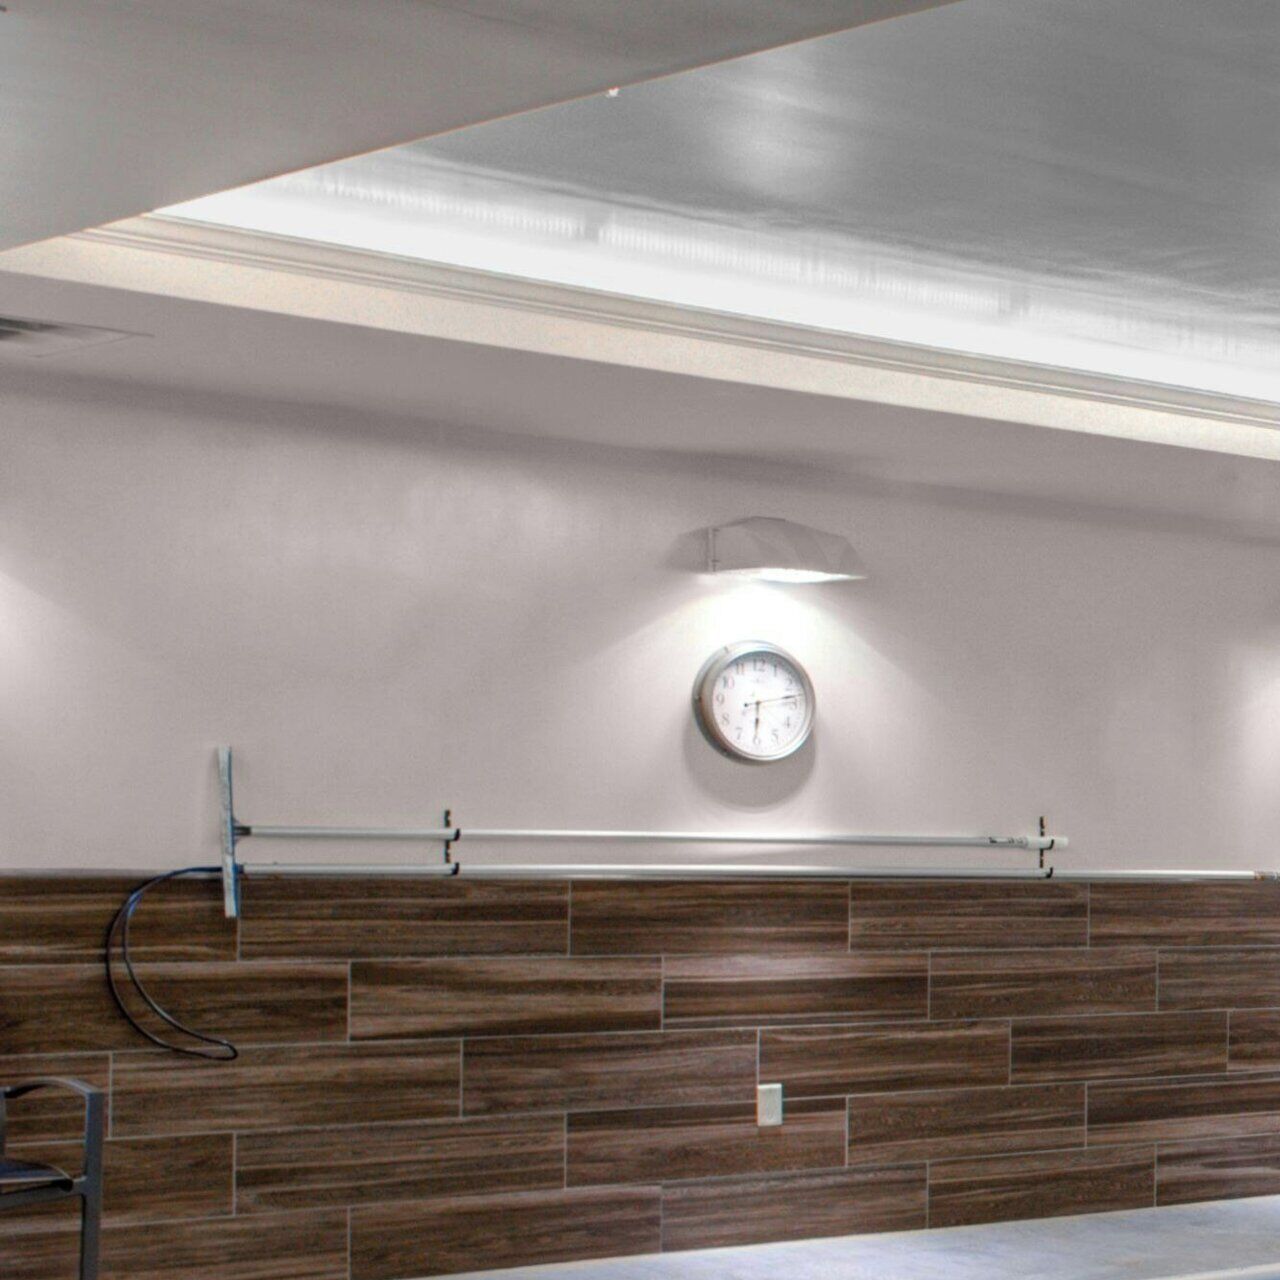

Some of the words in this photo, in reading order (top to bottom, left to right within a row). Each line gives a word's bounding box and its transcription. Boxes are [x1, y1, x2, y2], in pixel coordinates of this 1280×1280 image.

[753, 658, 766, 672] 12
[717, 693, 725, 704] 9
[721, 714, 730, 725] 8
[783, 716, 791, 728] 4
[735, 727, 743, 740] 7
[771, 729, 779, 744] 5
